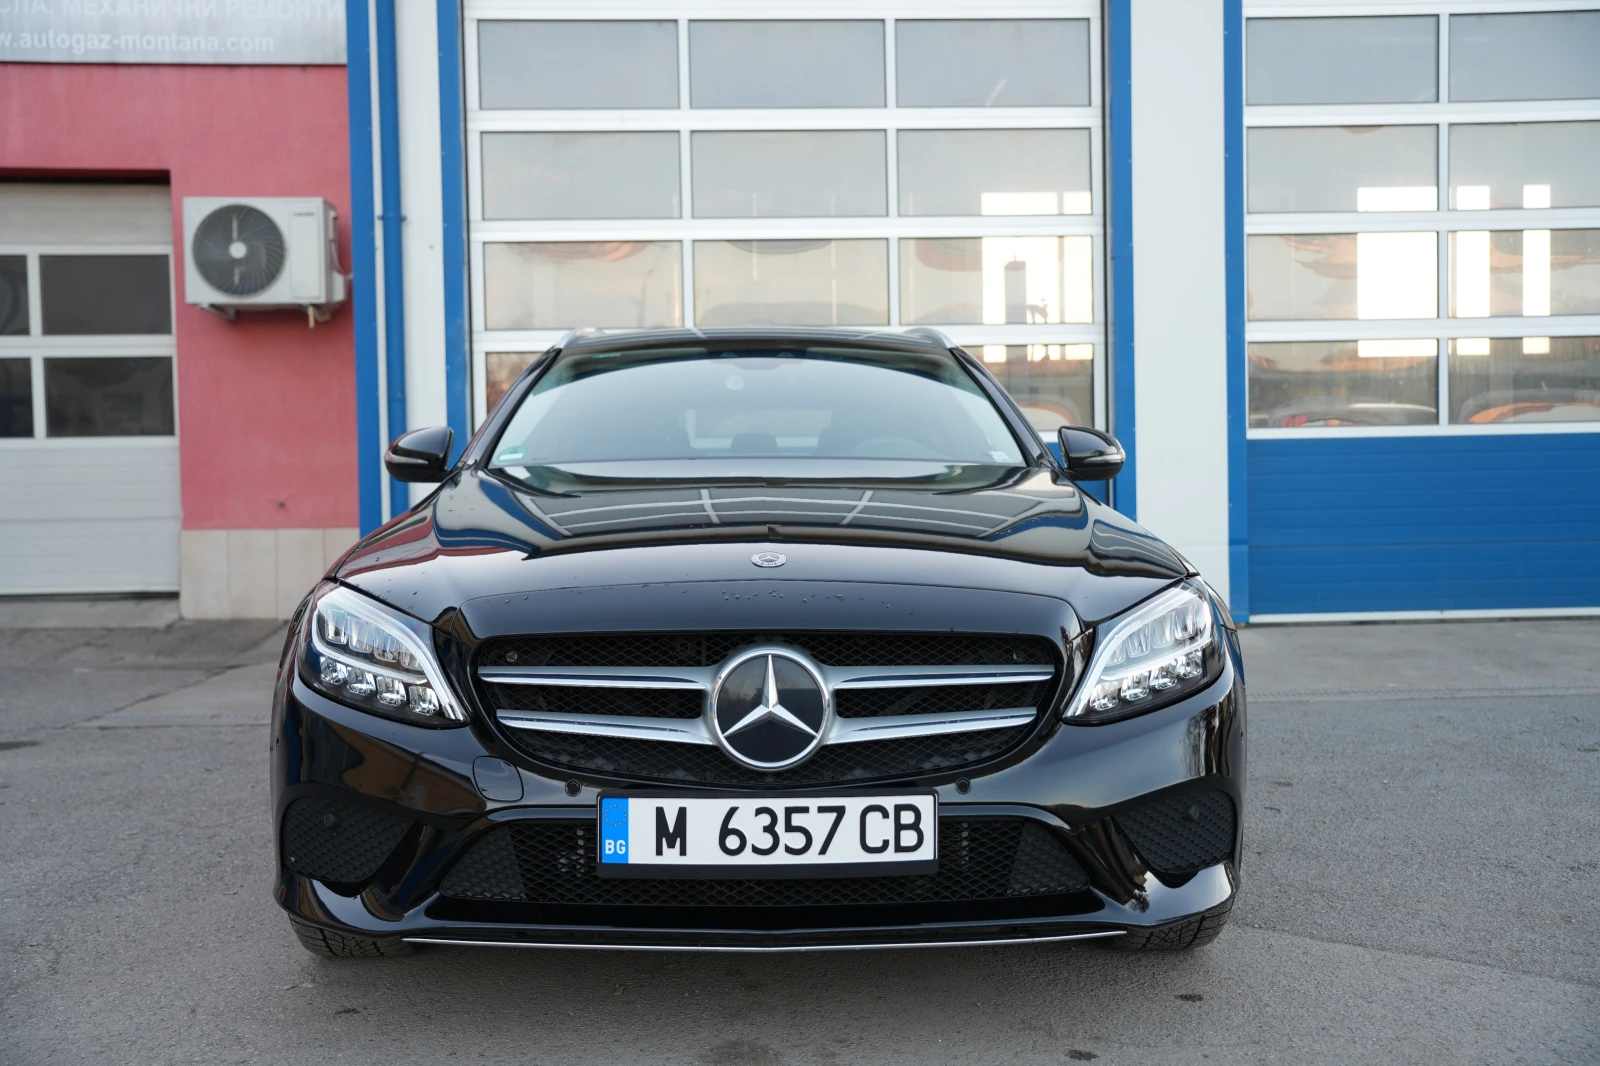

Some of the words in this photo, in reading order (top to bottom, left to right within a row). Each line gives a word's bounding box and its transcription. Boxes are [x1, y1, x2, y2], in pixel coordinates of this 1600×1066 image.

[63, 0, 218, 19] МЕХАНИЧНИ
[226, 0, 344, 20] РЕМОНТИ
[655, 806, 687, 856] M
[718, 805, 846, 856] 6357
[859, 803, 924, 854] CB
[604, 839, 627, 855] BG
